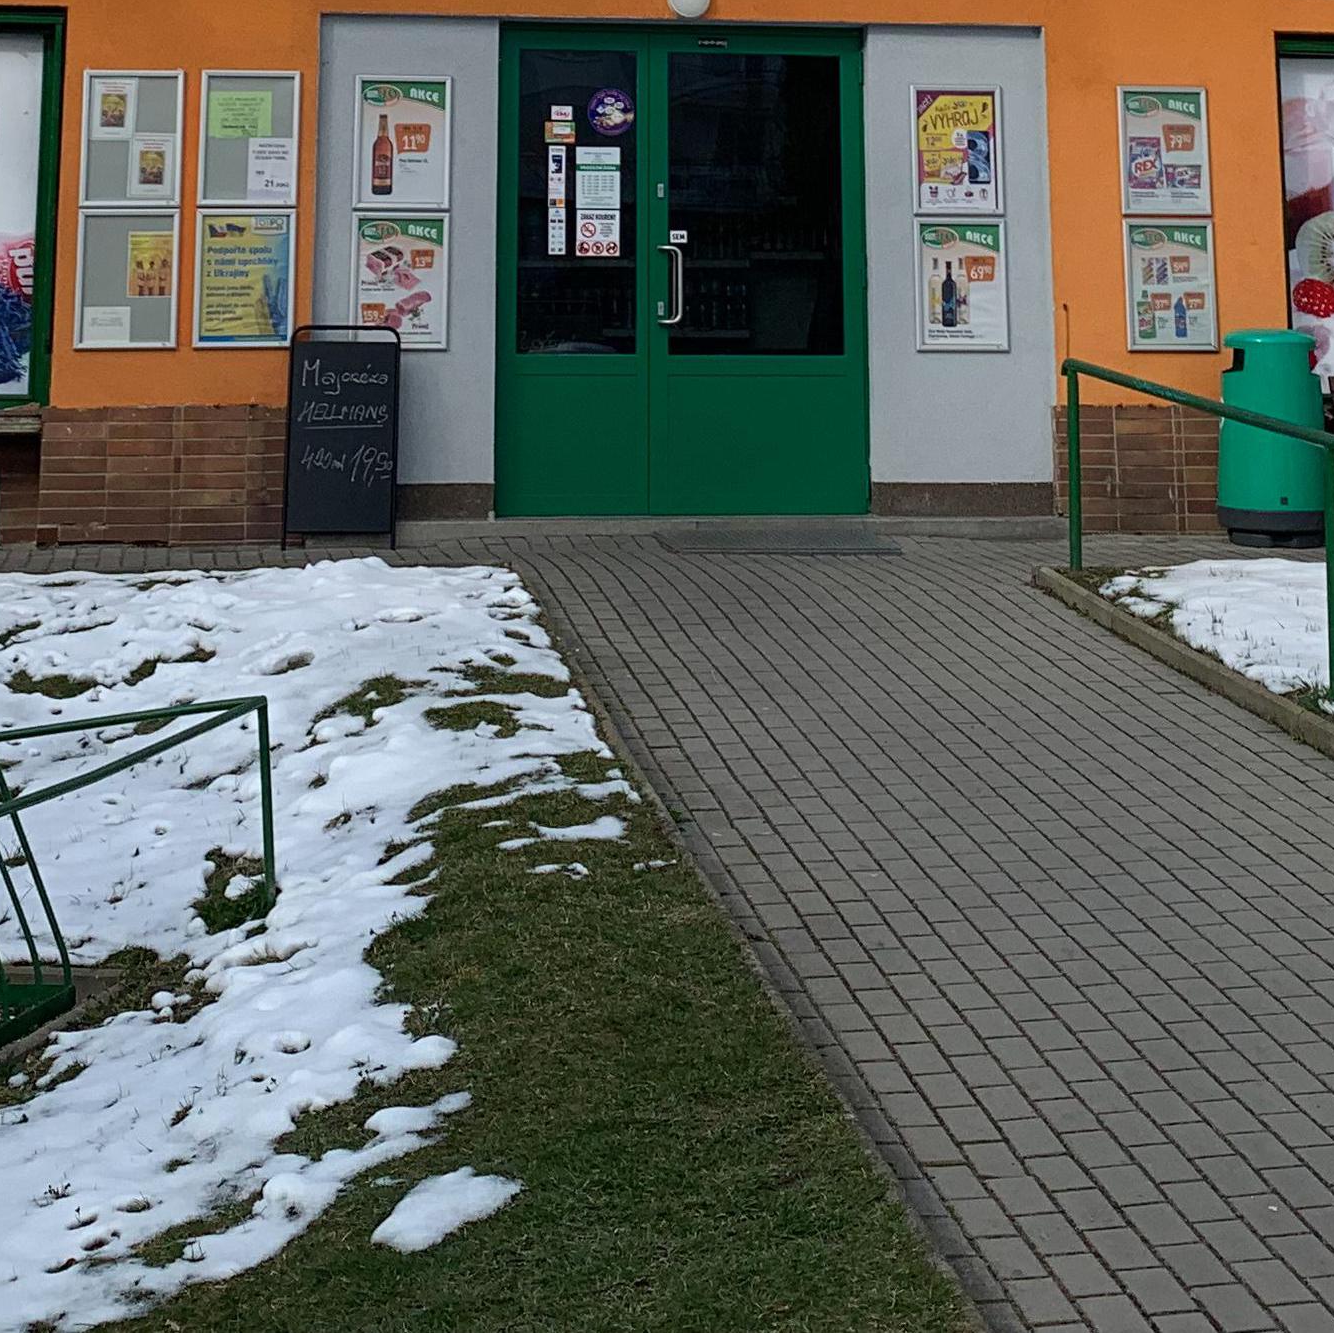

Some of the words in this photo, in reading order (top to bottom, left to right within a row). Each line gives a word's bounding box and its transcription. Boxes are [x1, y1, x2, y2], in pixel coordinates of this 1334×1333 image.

[409, 88, 440, 103] AKCE
[1168, 100, 1196, 114] AKCE
[1134, 158, 1158, 174] REX
[408, 225, 438, 240] AKCE
[672, 233, 685, 241] SEM
[966, 231, 994, 246] AKCE
[1174, 231, 1202, 246] AKCE
